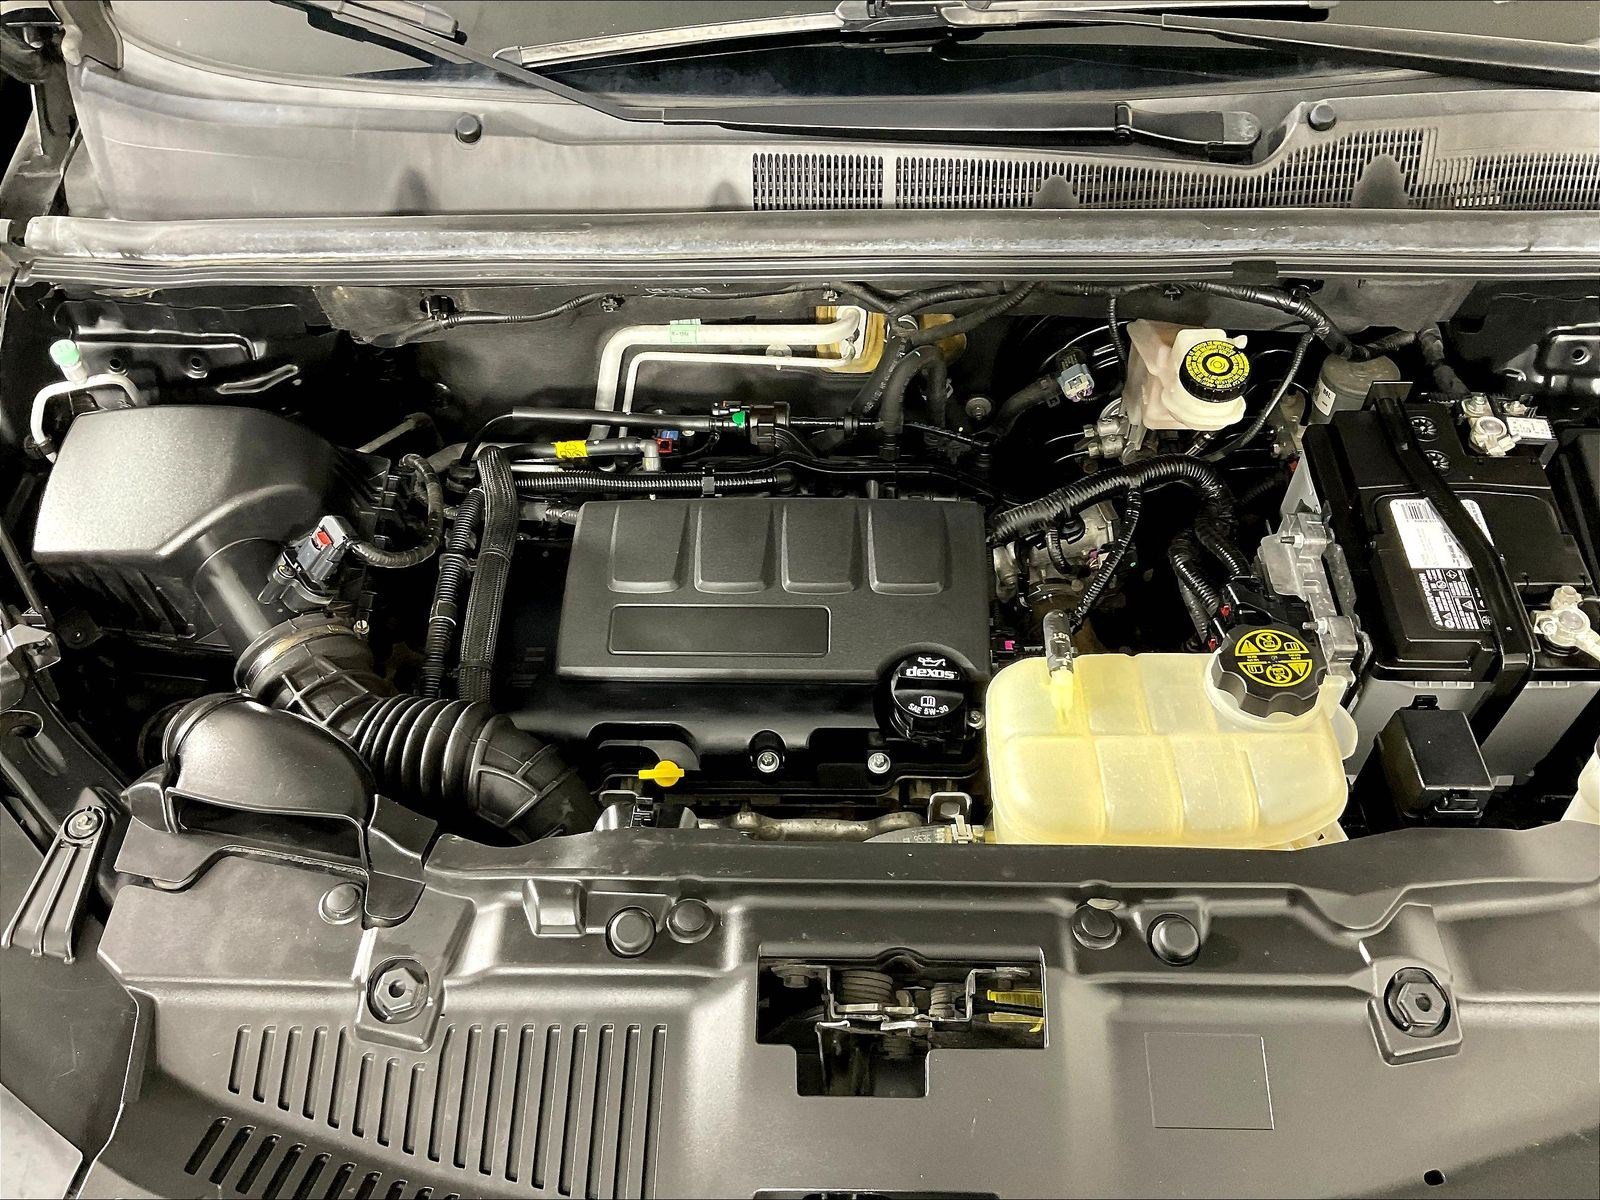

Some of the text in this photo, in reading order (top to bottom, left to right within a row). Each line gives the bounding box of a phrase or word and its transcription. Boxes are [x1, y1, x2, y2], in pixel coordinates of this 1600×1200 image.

[906, 666, 955, 679] dexos
[907, 703, 950, 716] SAE 5W-30
